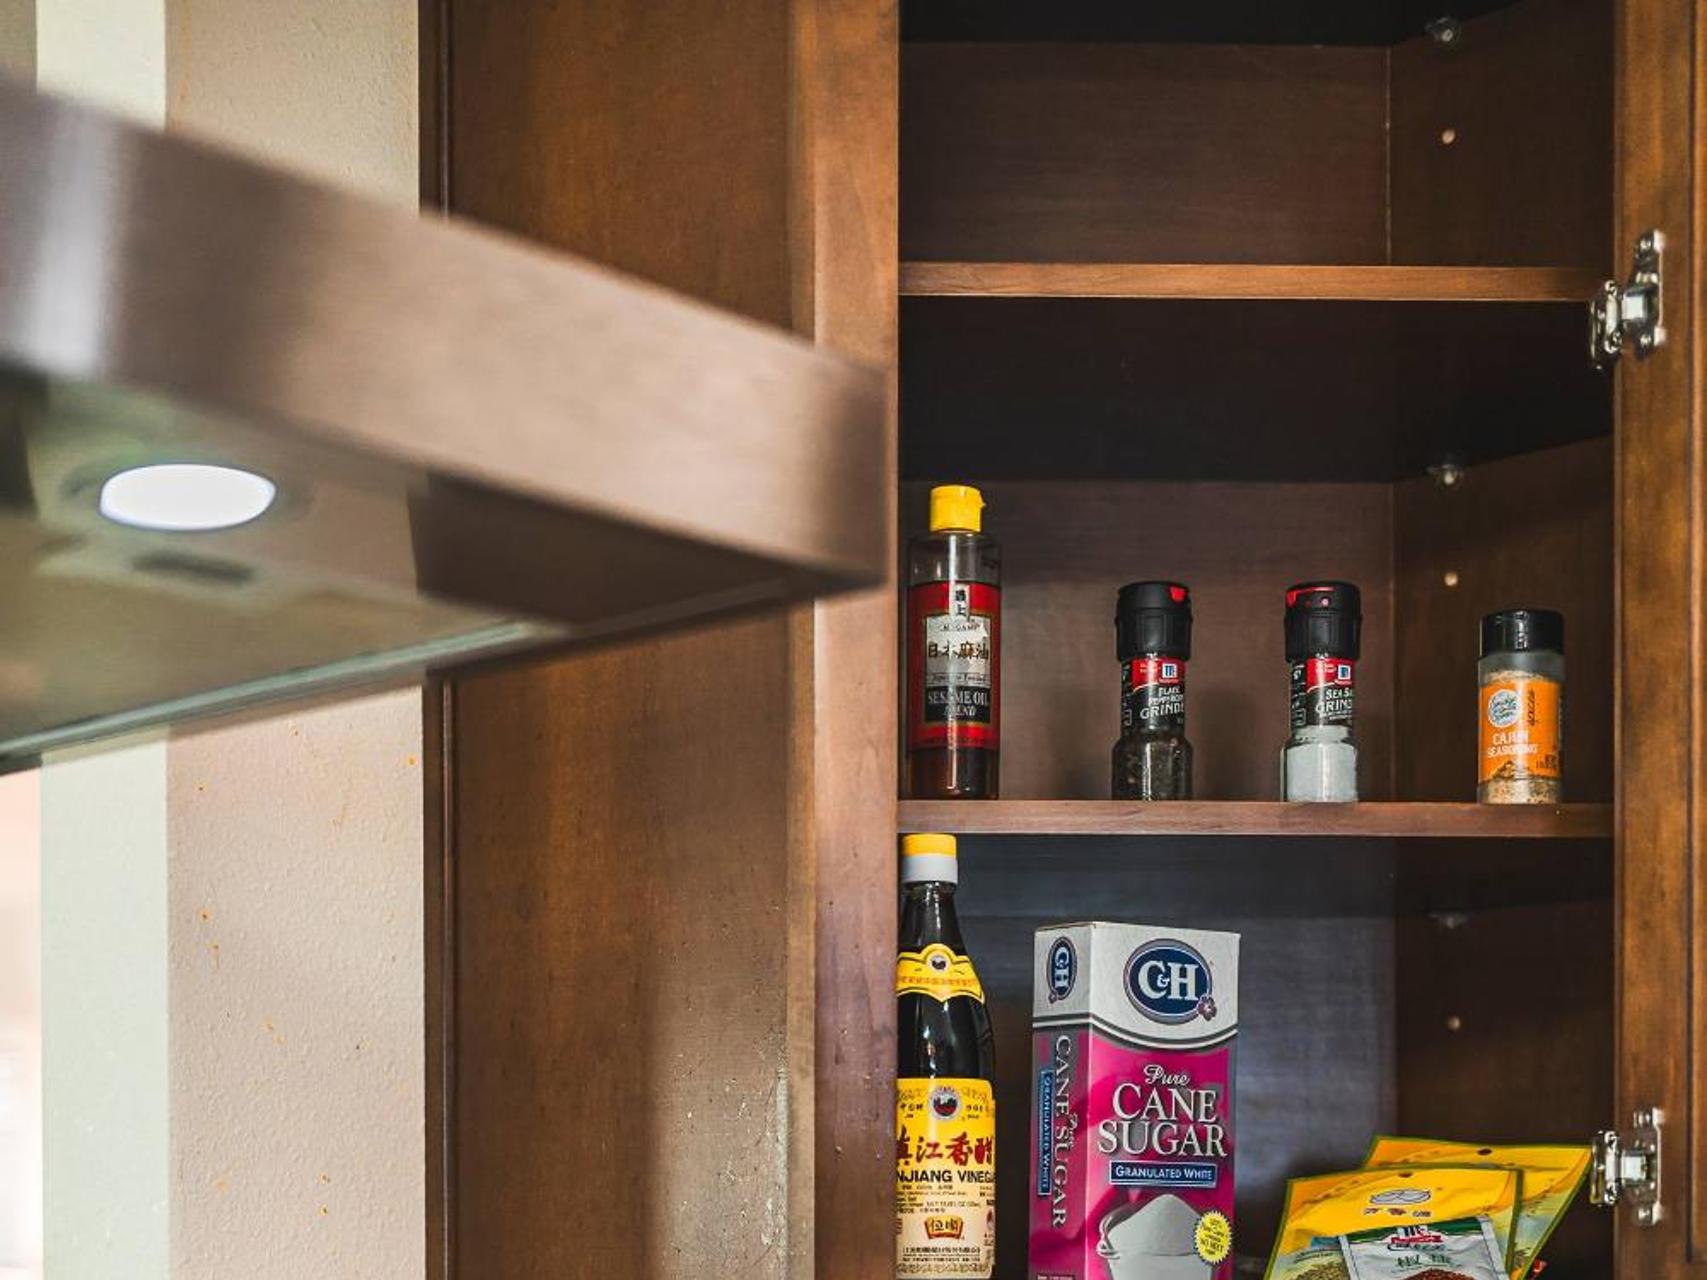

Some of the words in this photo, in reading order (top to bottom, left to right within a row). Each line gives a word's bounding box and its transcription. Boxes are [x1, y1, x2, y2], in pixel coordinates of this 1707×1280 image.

[1138, 960, 1200, 1001] C&H
[1054, 1035, 1072, 1117] CANE
[1143, 1064, 1190, 1086] Pure
[1112, 1082, 1218, 1123] CANE
[1097, 1119, 1228, 1158] SUGAR
[957, 1169, 993, 1184] VINEG
[1052, 1119, 1071, 1228] SUGAR
